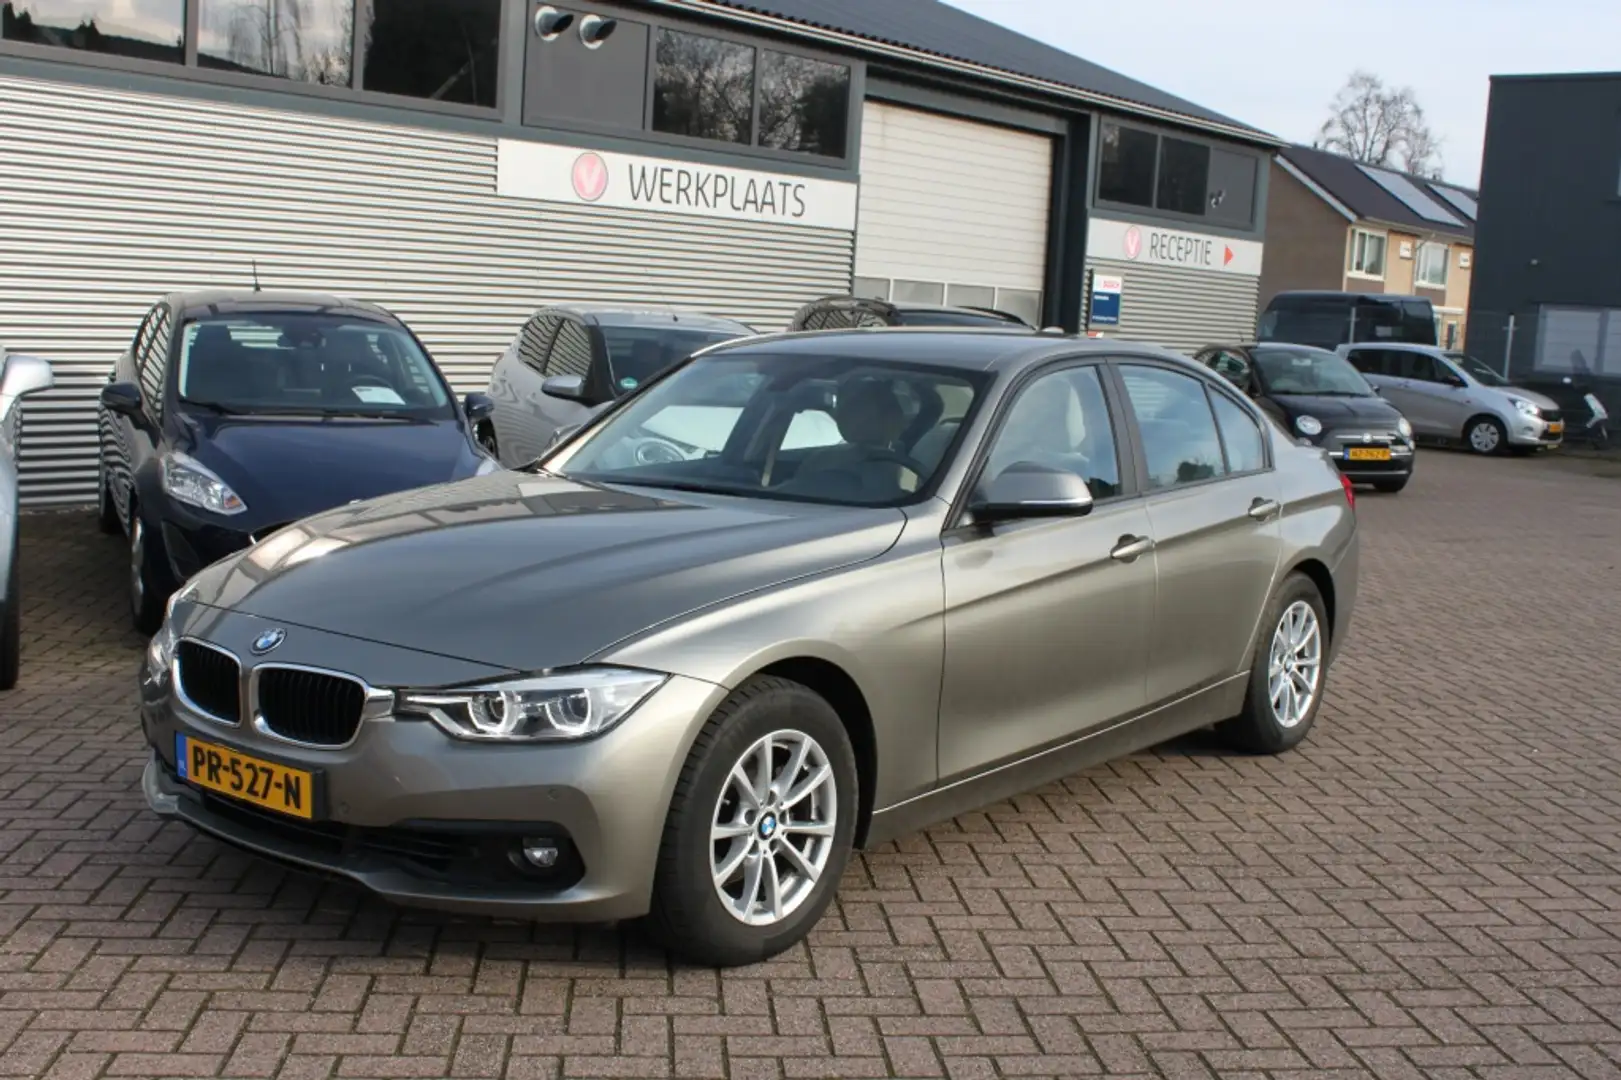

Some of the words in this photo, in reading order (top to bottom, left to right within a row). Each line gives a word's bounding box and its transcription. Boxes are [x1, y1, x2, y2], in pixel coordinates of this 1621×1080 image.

[628, 163, 806, 218] WERKPLAATS
[1149, 232, 1213, 266] RECEPTIE
[193, 745, 302, 810] PR-527-N
